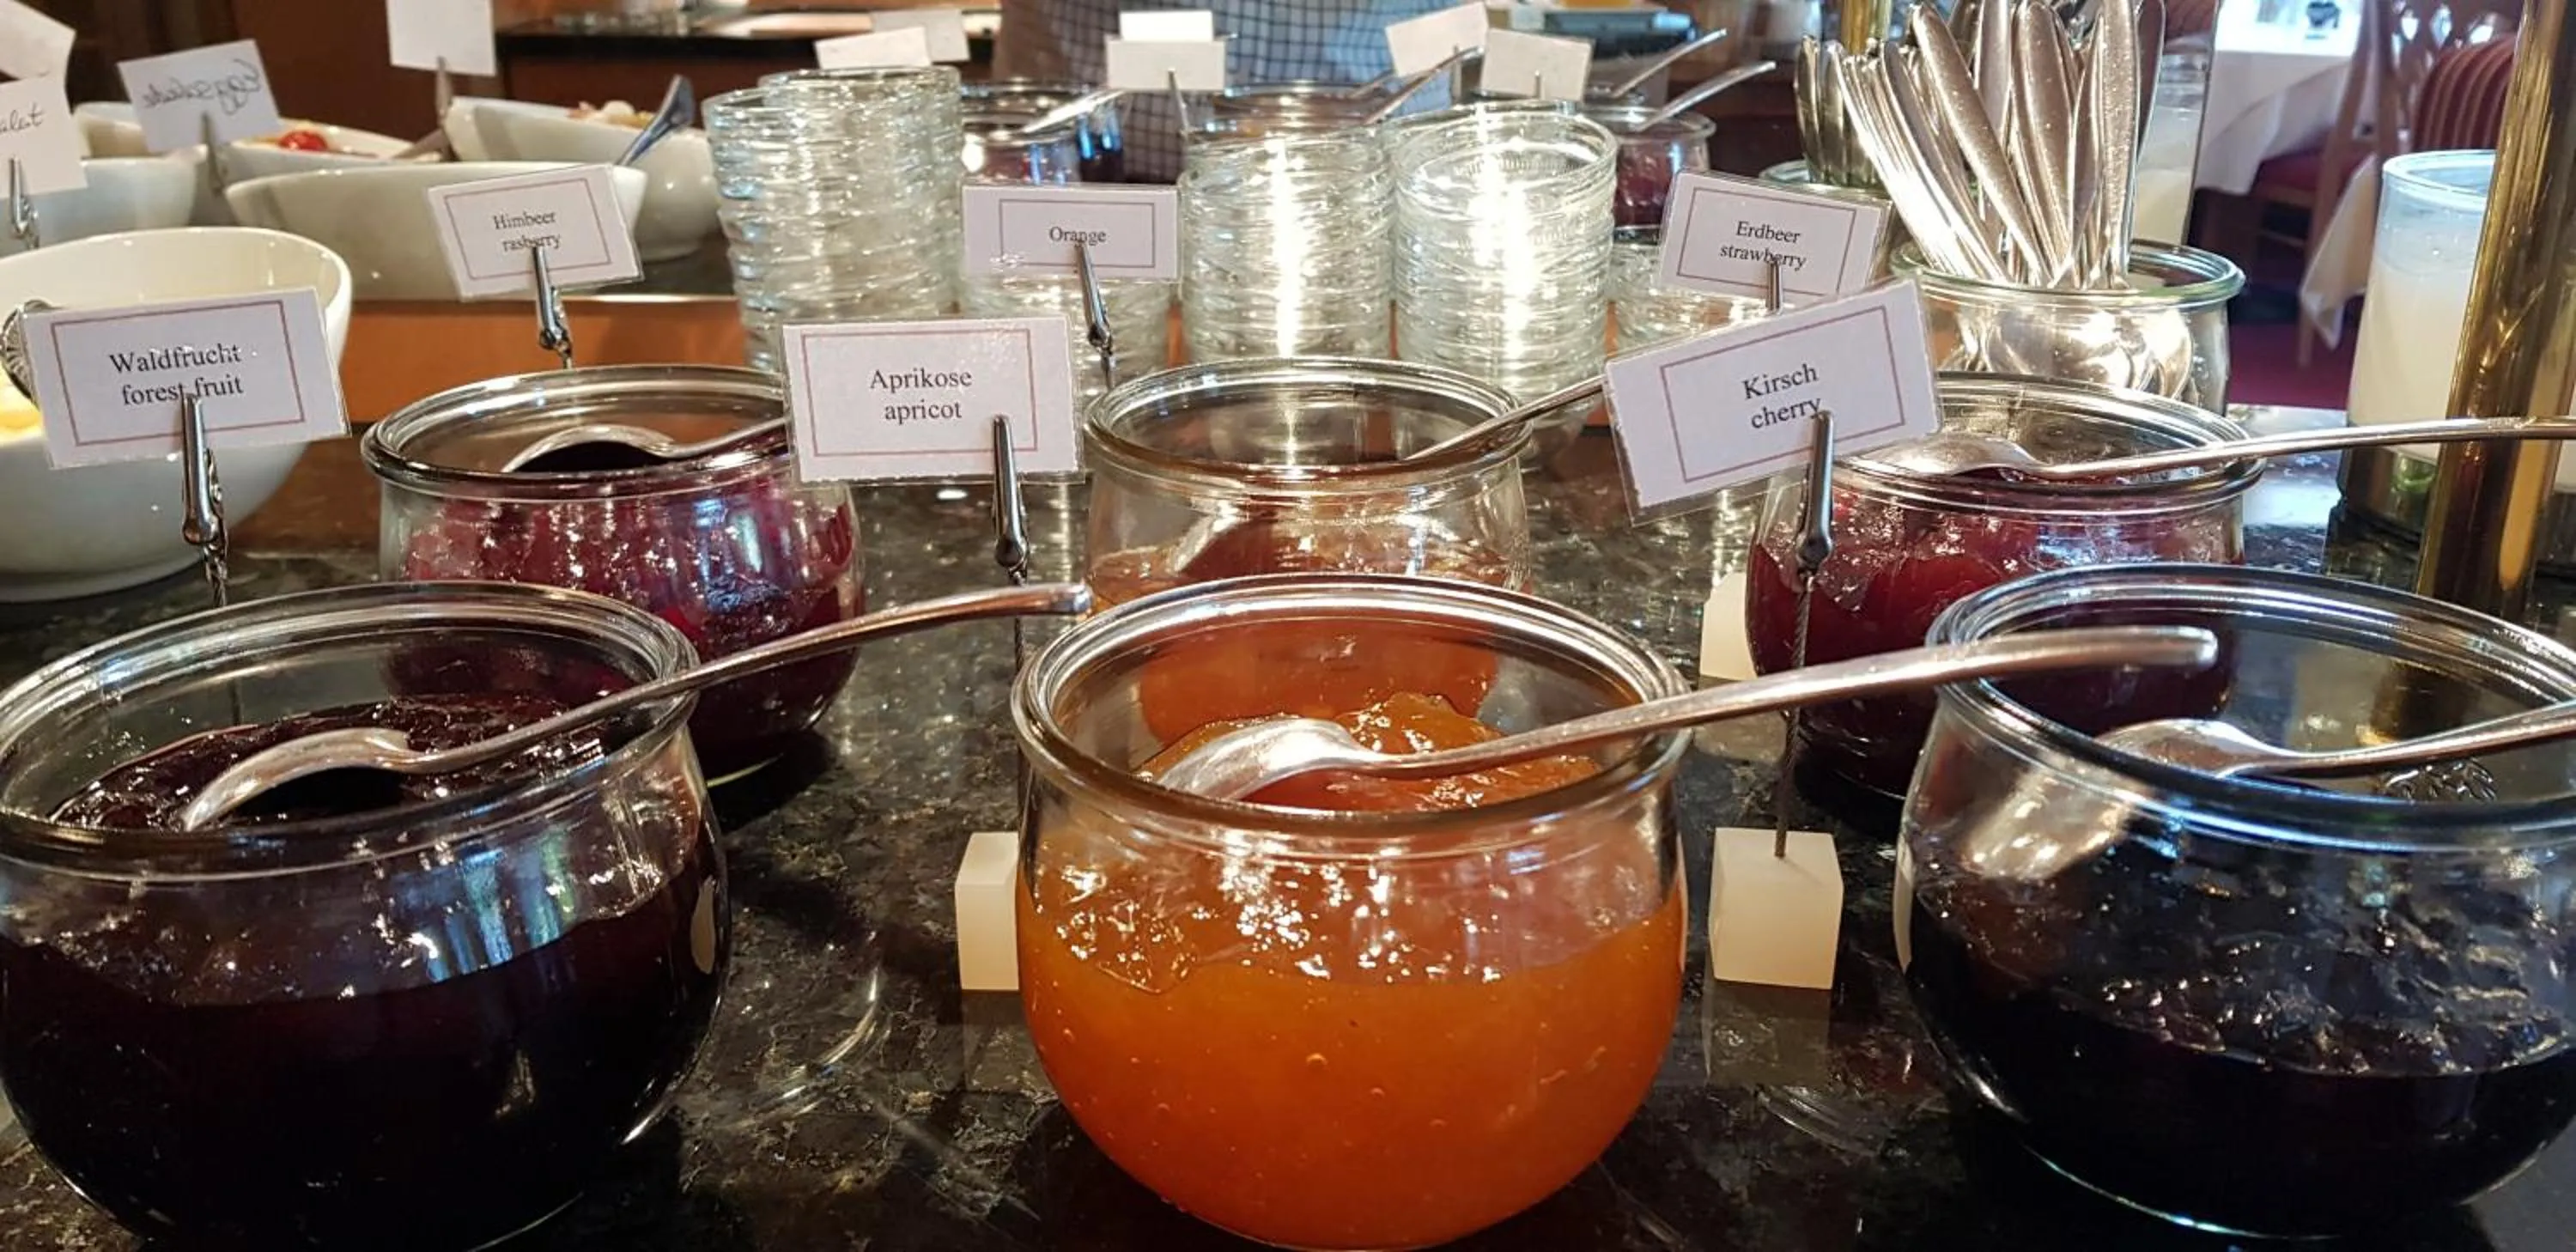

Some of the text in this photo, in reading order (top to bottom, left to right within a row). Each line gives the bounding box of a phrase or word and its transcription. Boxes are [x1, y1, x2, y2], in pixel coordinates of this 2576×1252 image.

[493, 210, 556, 230] Himbeer
[1735, 220, 1801, 244] Erdbeer
[1048, 225, 1107, 246] Orange
[1719, 244, 1807, 272] strawberry
[109, 343, 242, 374] Waldfrucht
[121, 373, 244, 406] forest fruit
[870, 367, 973, 394] Aprikose
[1741, 362, 1820, 400] Kirsch
[884, 398, 963, 425] apricot
[1751, 398, 1821, 428] cherry
